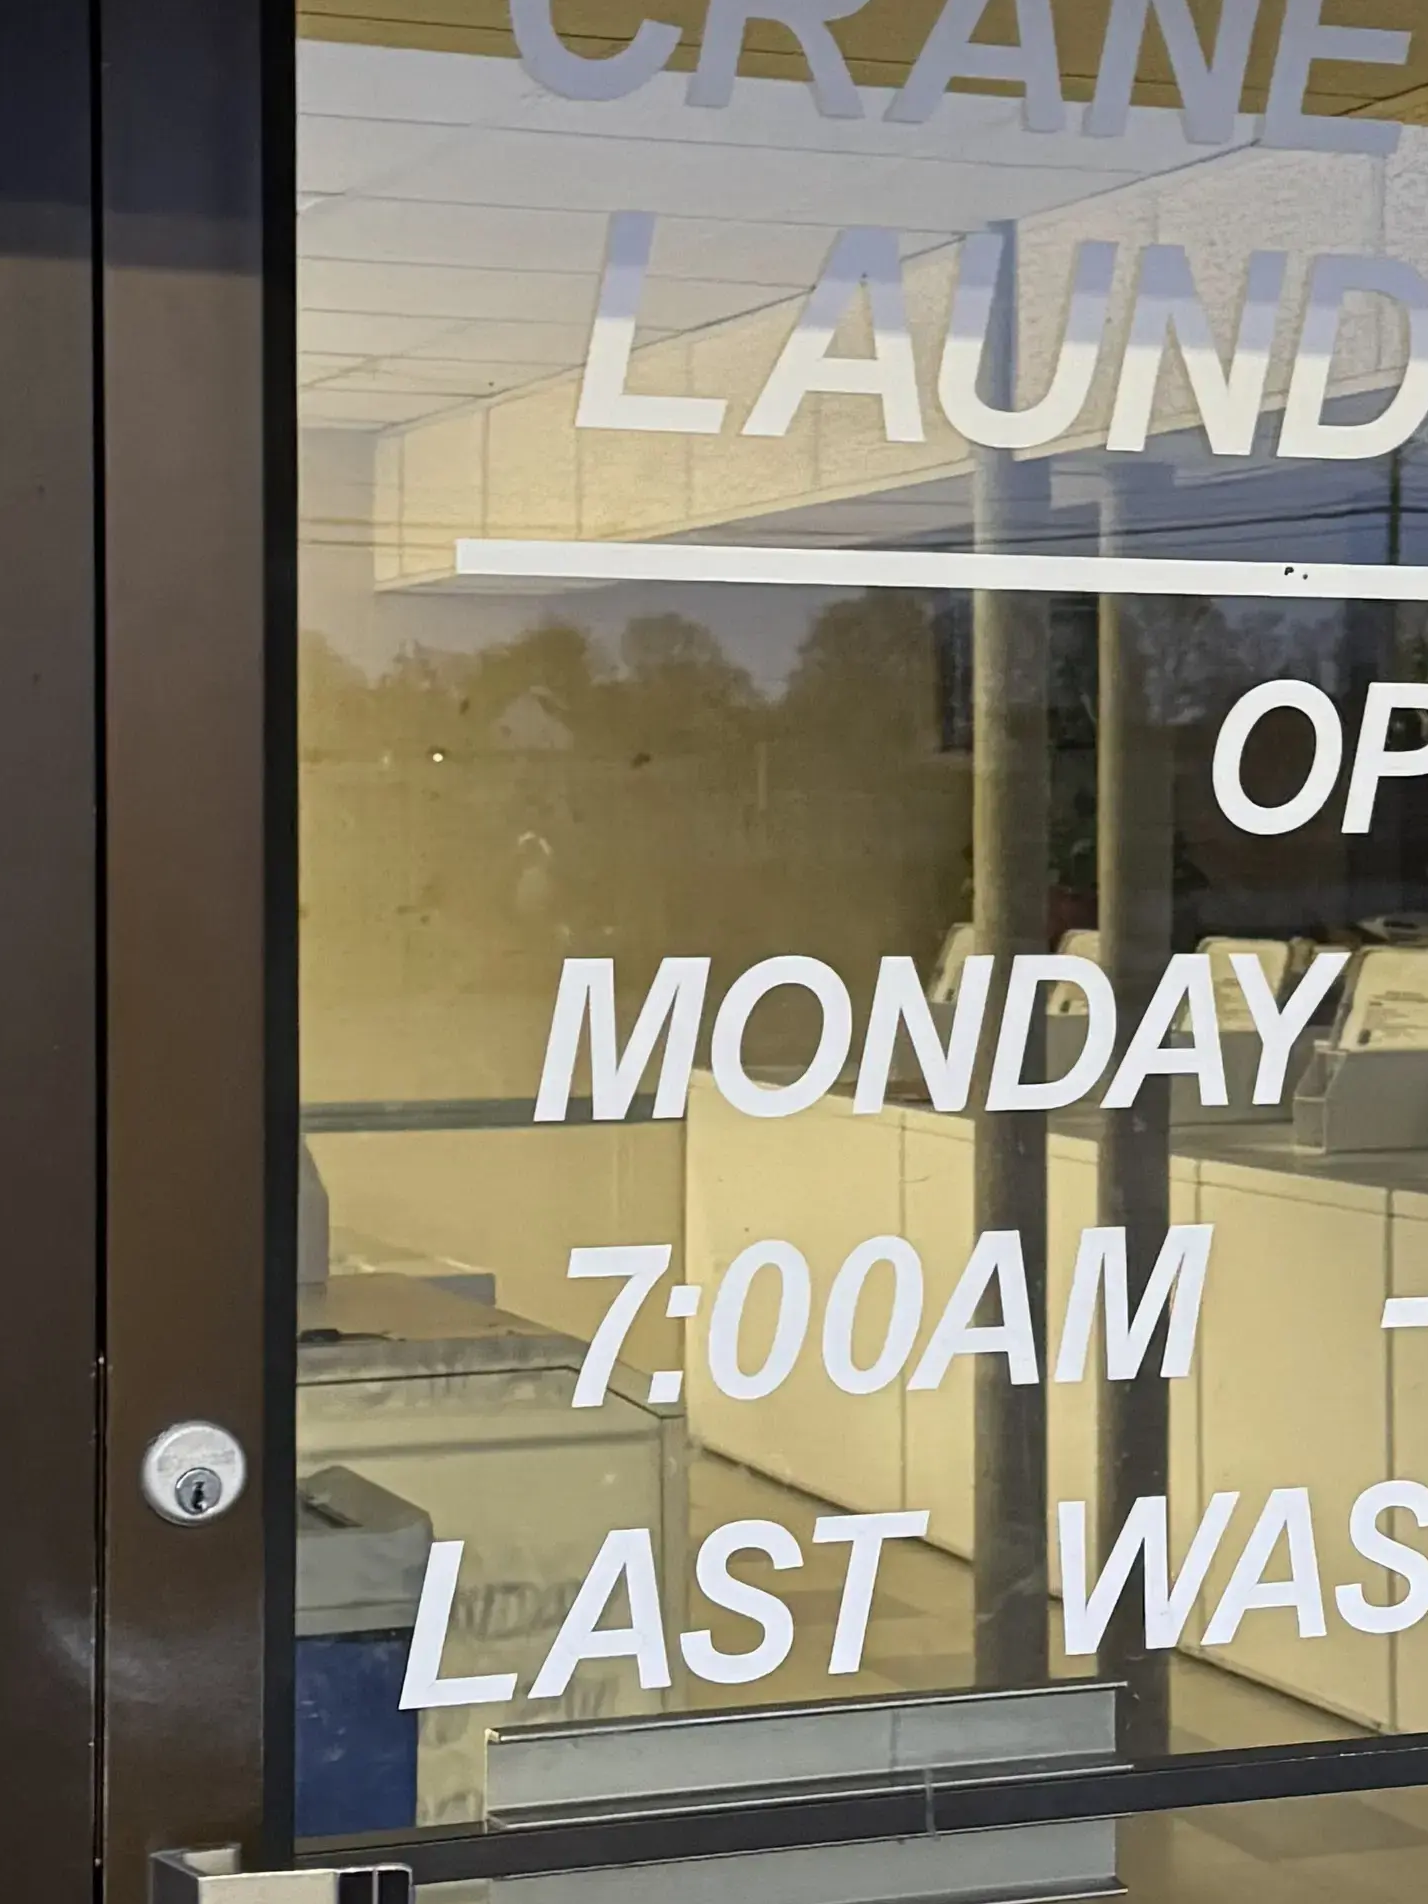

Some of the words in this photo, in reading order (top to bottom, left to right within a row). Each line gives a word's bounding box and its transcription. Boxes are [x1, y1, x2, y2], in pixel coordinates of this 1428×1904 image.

[533, 951, 1351, 1122] MONDAY
[566, 1222, 1215, 1408] 7:00AM
[398, 1508, 931, 1711] LAST
